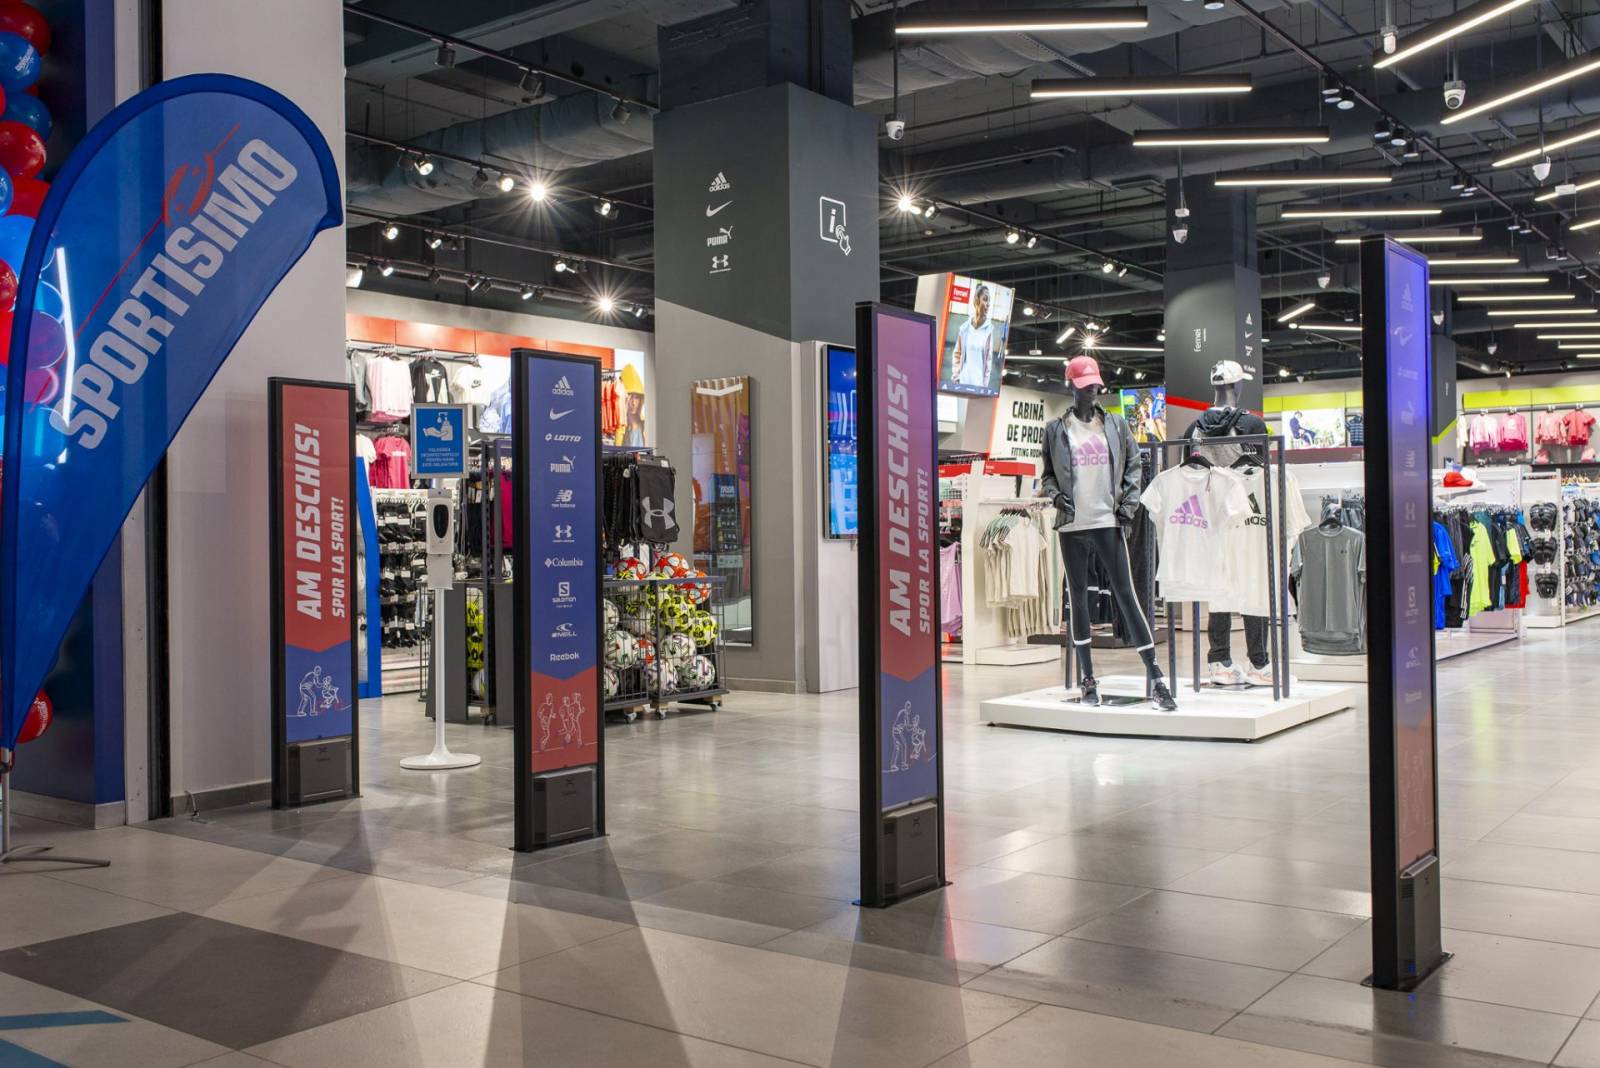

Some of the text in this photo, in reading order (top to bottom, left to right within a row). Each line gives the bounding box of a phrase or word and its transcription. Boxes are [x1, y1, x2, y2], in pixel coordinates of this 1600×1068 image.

[708, 182, 731, 192] adidas
[49, 138, 298, 450] SPORTISIMO
[551, 388, 574, 397] adidas
[1012, 399, 1045, 421] CABINĂ
[553, 433, 582, 443] LOTTO
[1006, 423, 1046, 444] DE PROB
[550, 463, 572, 473] PUMA
[1071, 454, 1108, 468] adida
[887, 364, 911, 638] AM DESCHIS!
[294, 423, 322, 621] AM DESCHIS!
[1168, 514, 1209, 530] adidas
[330, 496, 345, 618] SPOR LA SPORT!
[917, 467, 931, 635] SPOR LA SPORT!
[552, 557, 583, 567] Columbia
[550, 651, 580, 662] Reebok
